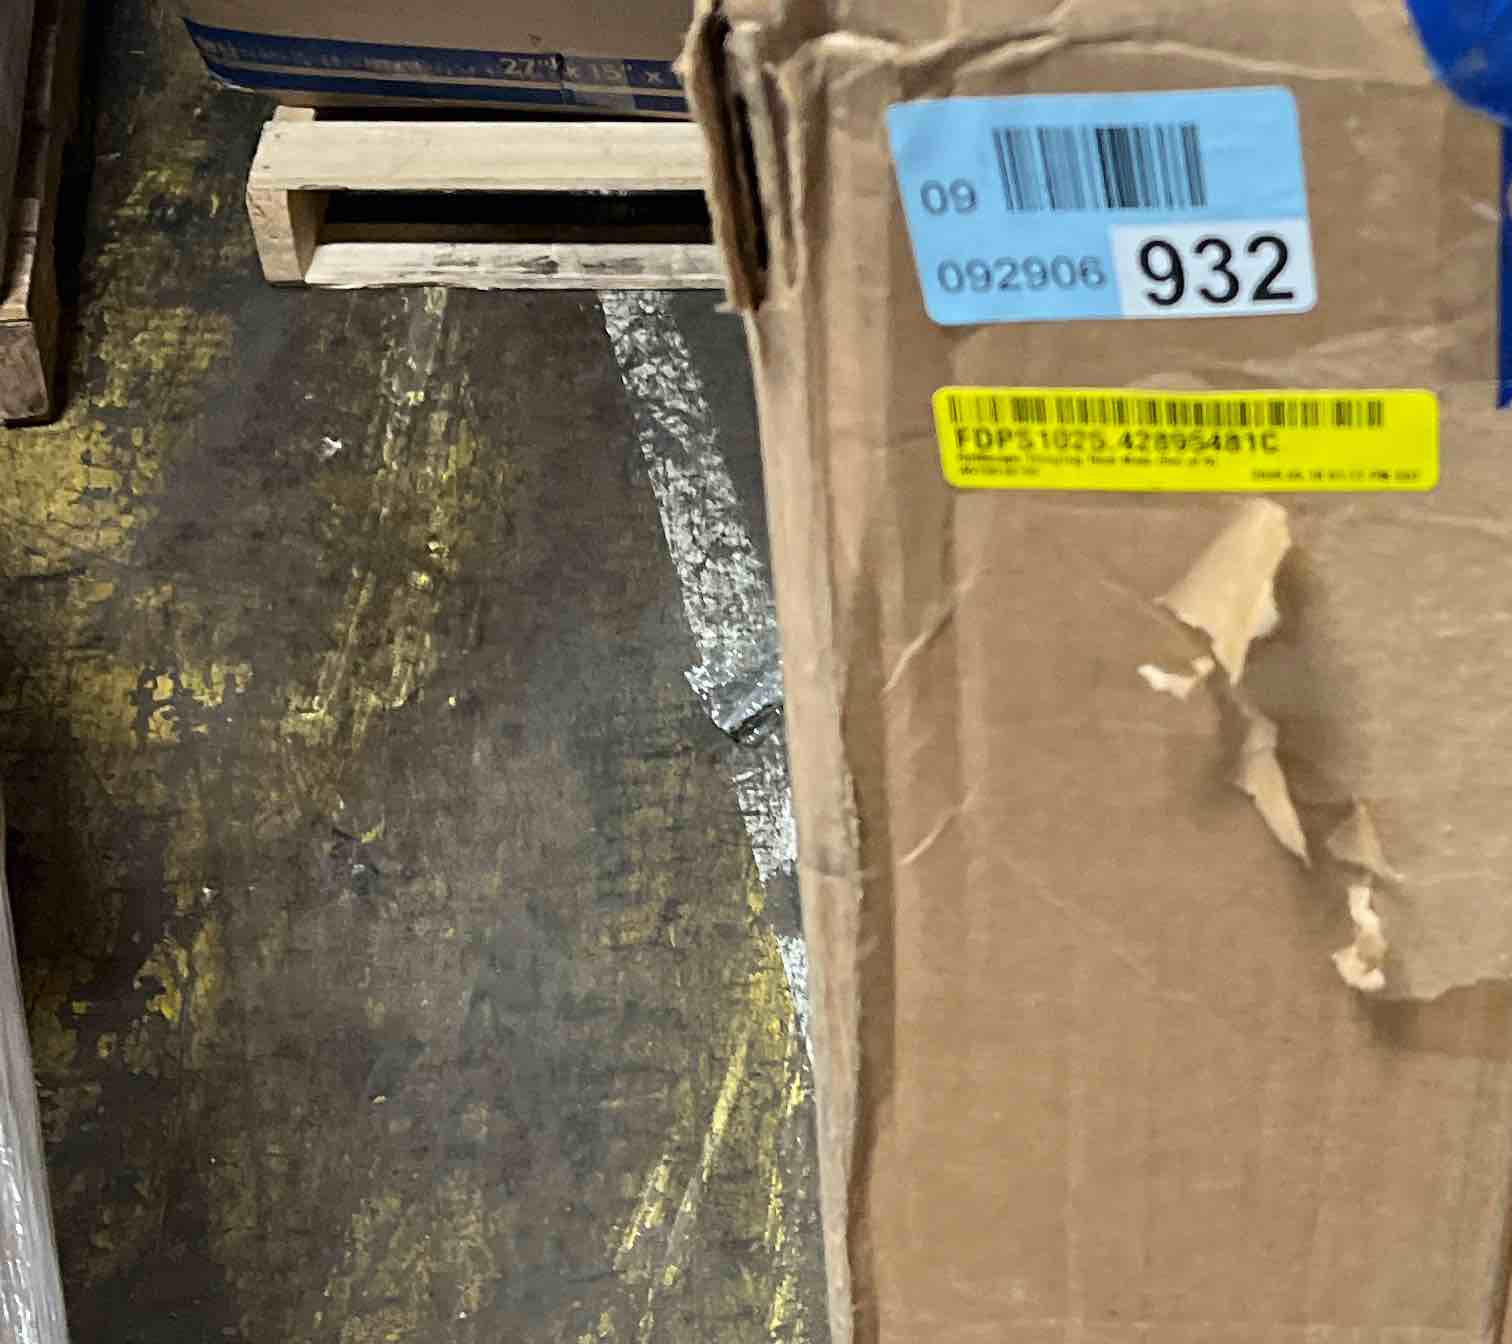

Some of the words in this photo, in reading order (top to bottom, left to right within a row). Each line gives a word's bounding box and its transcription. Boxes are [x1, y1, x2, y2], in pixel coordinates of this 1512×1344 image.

[919, 178, 978, 216] 09
[936, 256, 1108, 294] 092906
[1138, 234, 1295, 307] 932
